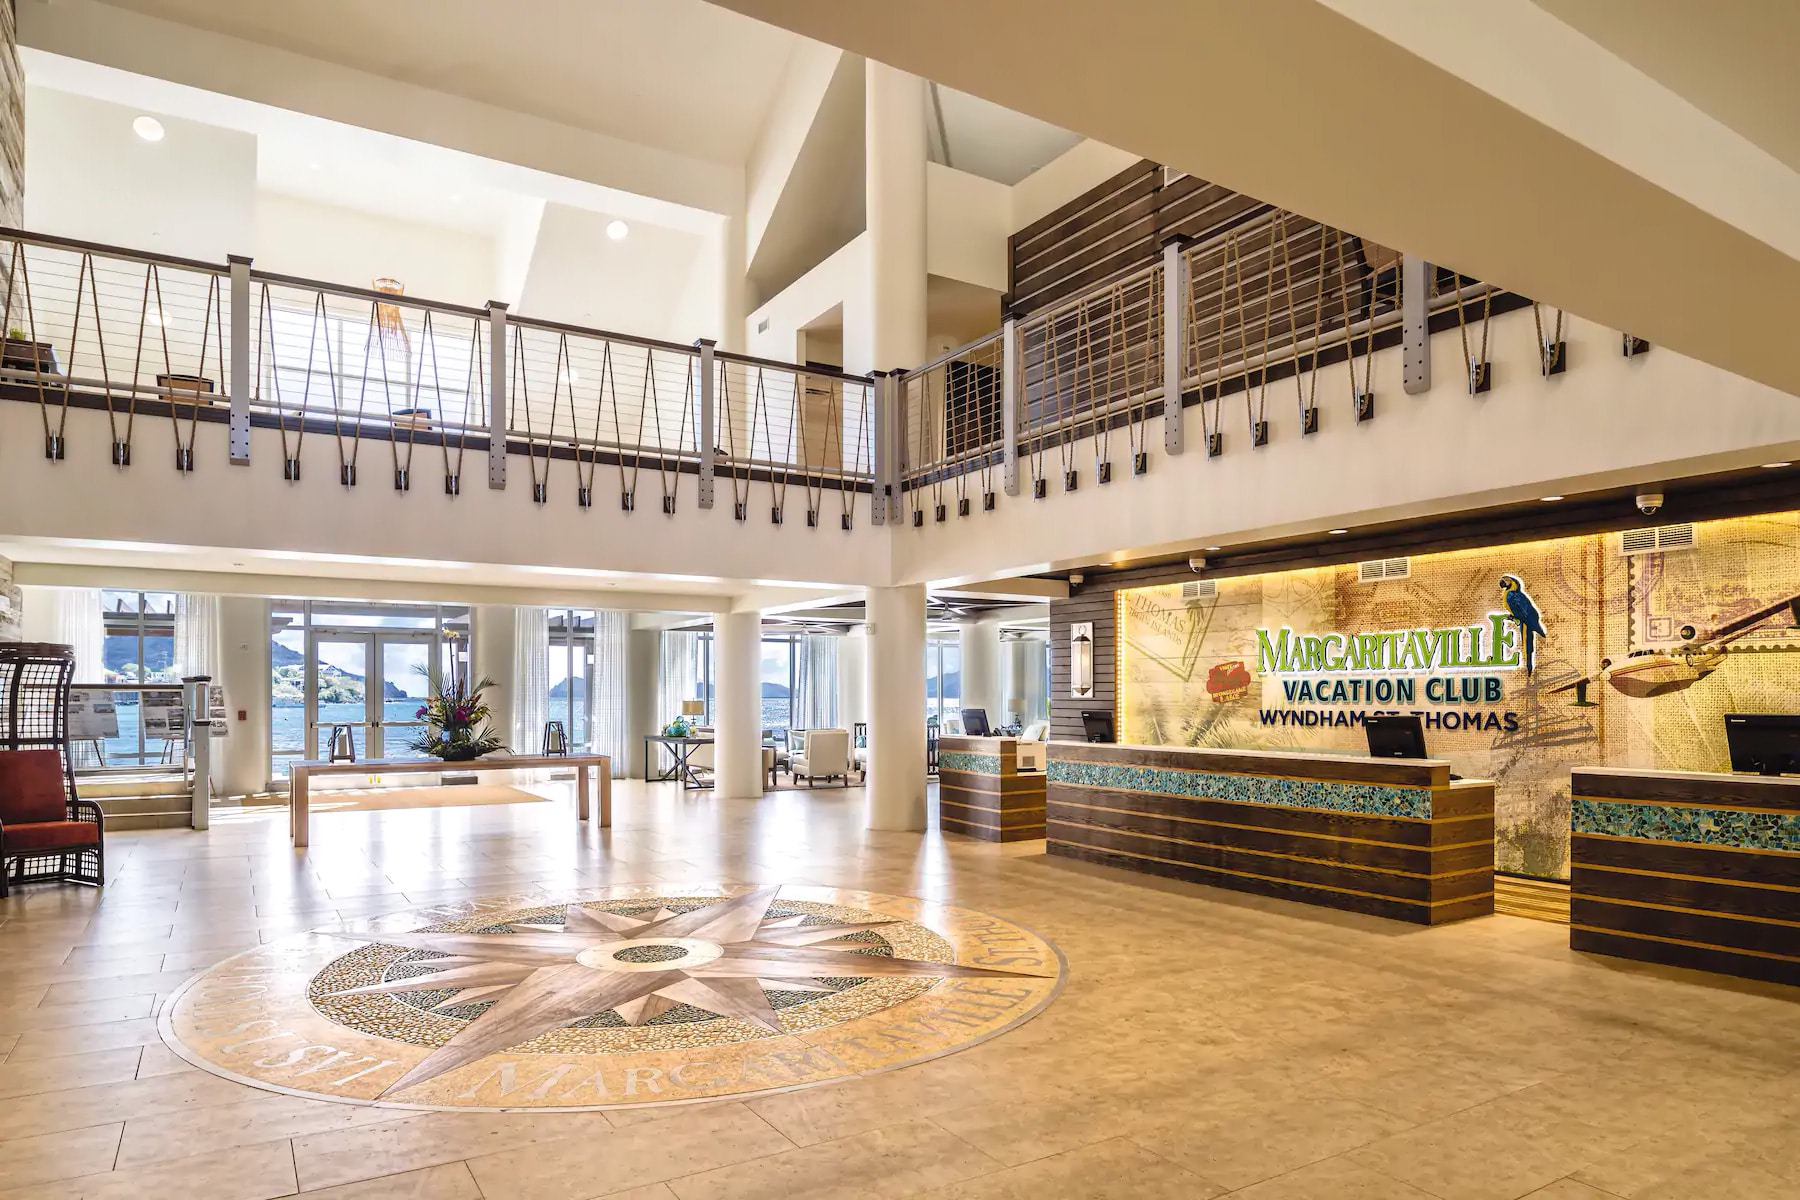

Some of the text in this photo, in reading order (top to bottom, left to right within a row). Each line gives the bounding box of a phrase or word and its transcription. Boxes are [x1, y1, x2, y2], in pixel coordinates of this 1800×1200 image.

[1135, 594, 1186, 632] THOMAS
[1283, 676, 1503, 703] VACATION CLUB
[1259, 709, 1519, 732] WYNDHAM HOMAS
